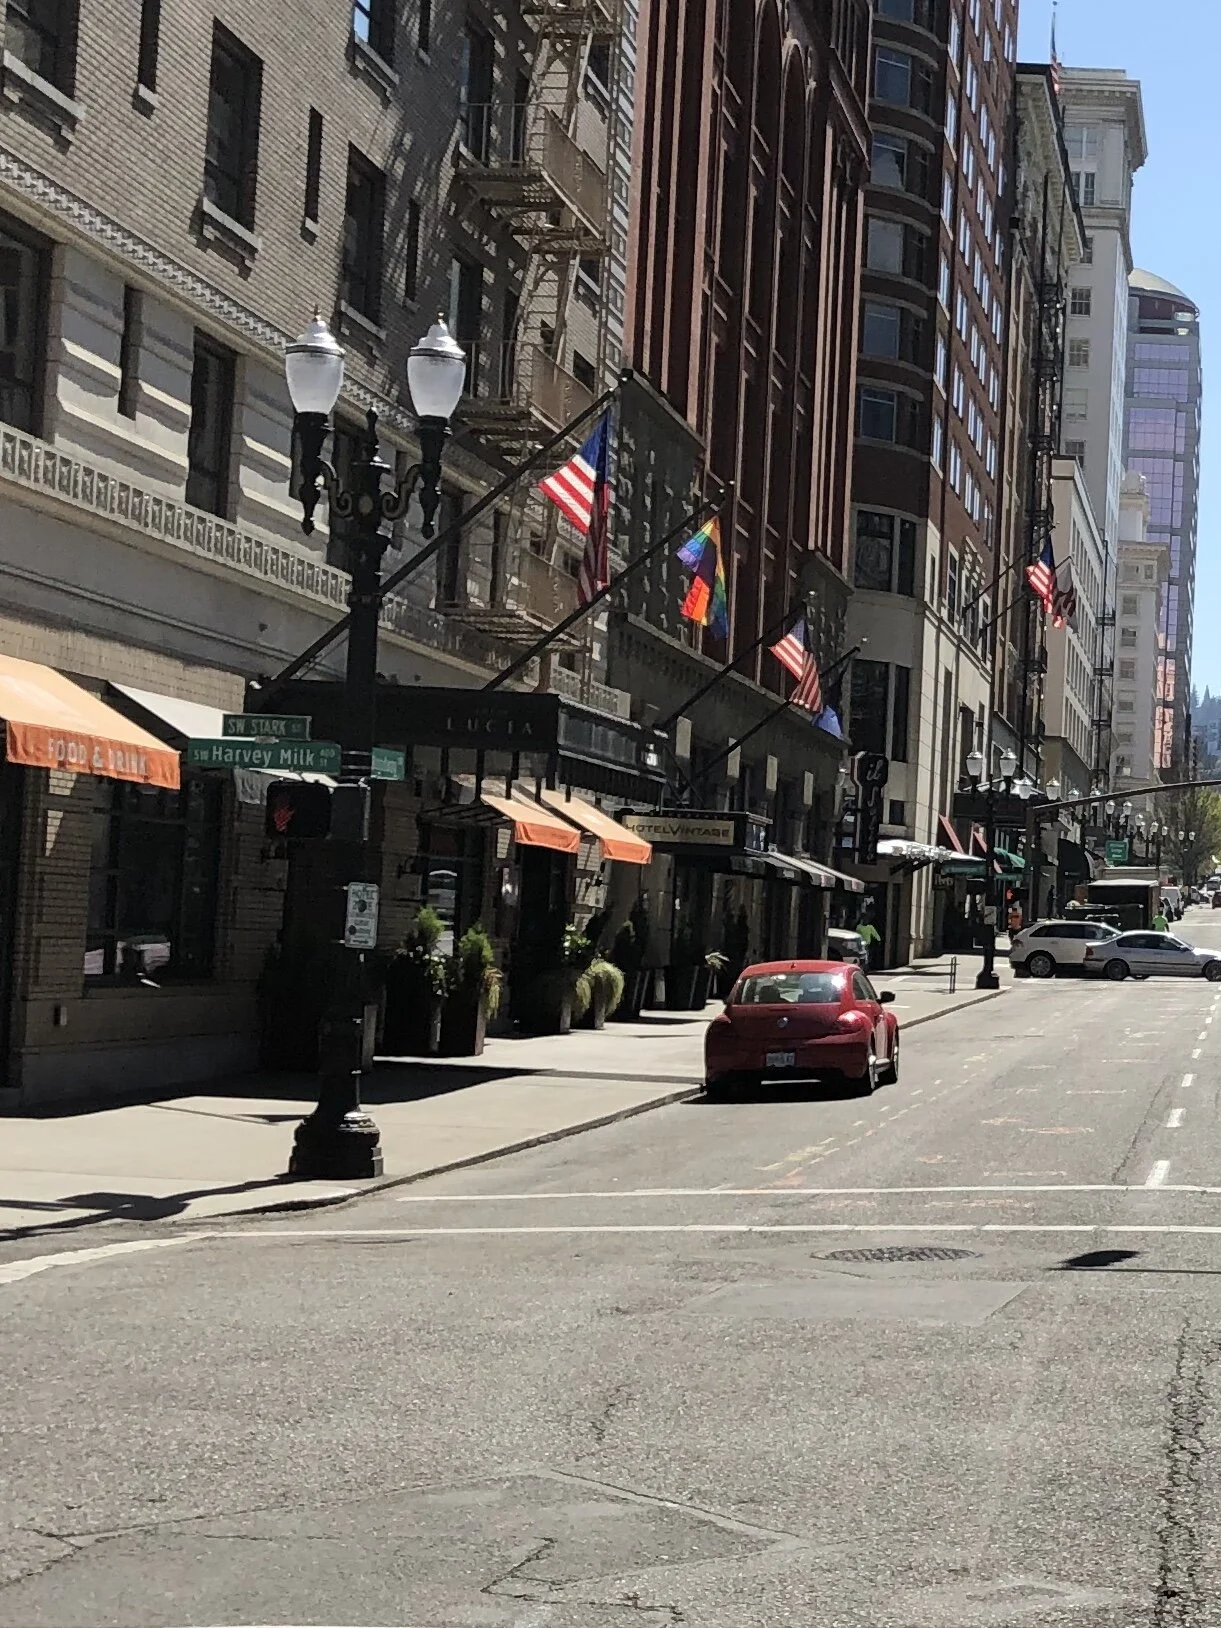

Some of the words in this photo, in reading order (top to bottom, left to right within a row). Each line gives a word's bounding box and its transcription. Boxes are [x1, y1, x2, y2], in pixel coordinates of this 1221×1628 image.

[228, 719, 245, 734] SW
[252, 719, 287, 736] STARK
[447, 717, 532, 735] LUCIA
[48, 737, 87, 765] FOOD
[93, 745, 103, 768] &
[108, 748, 149, 777] DRINK
[194, 750, 208, 761] SW
[212, 745, 272, 767] Harvey
[279, 748, 315, 766] Milk
[352, 900, 373, 912] ZE
